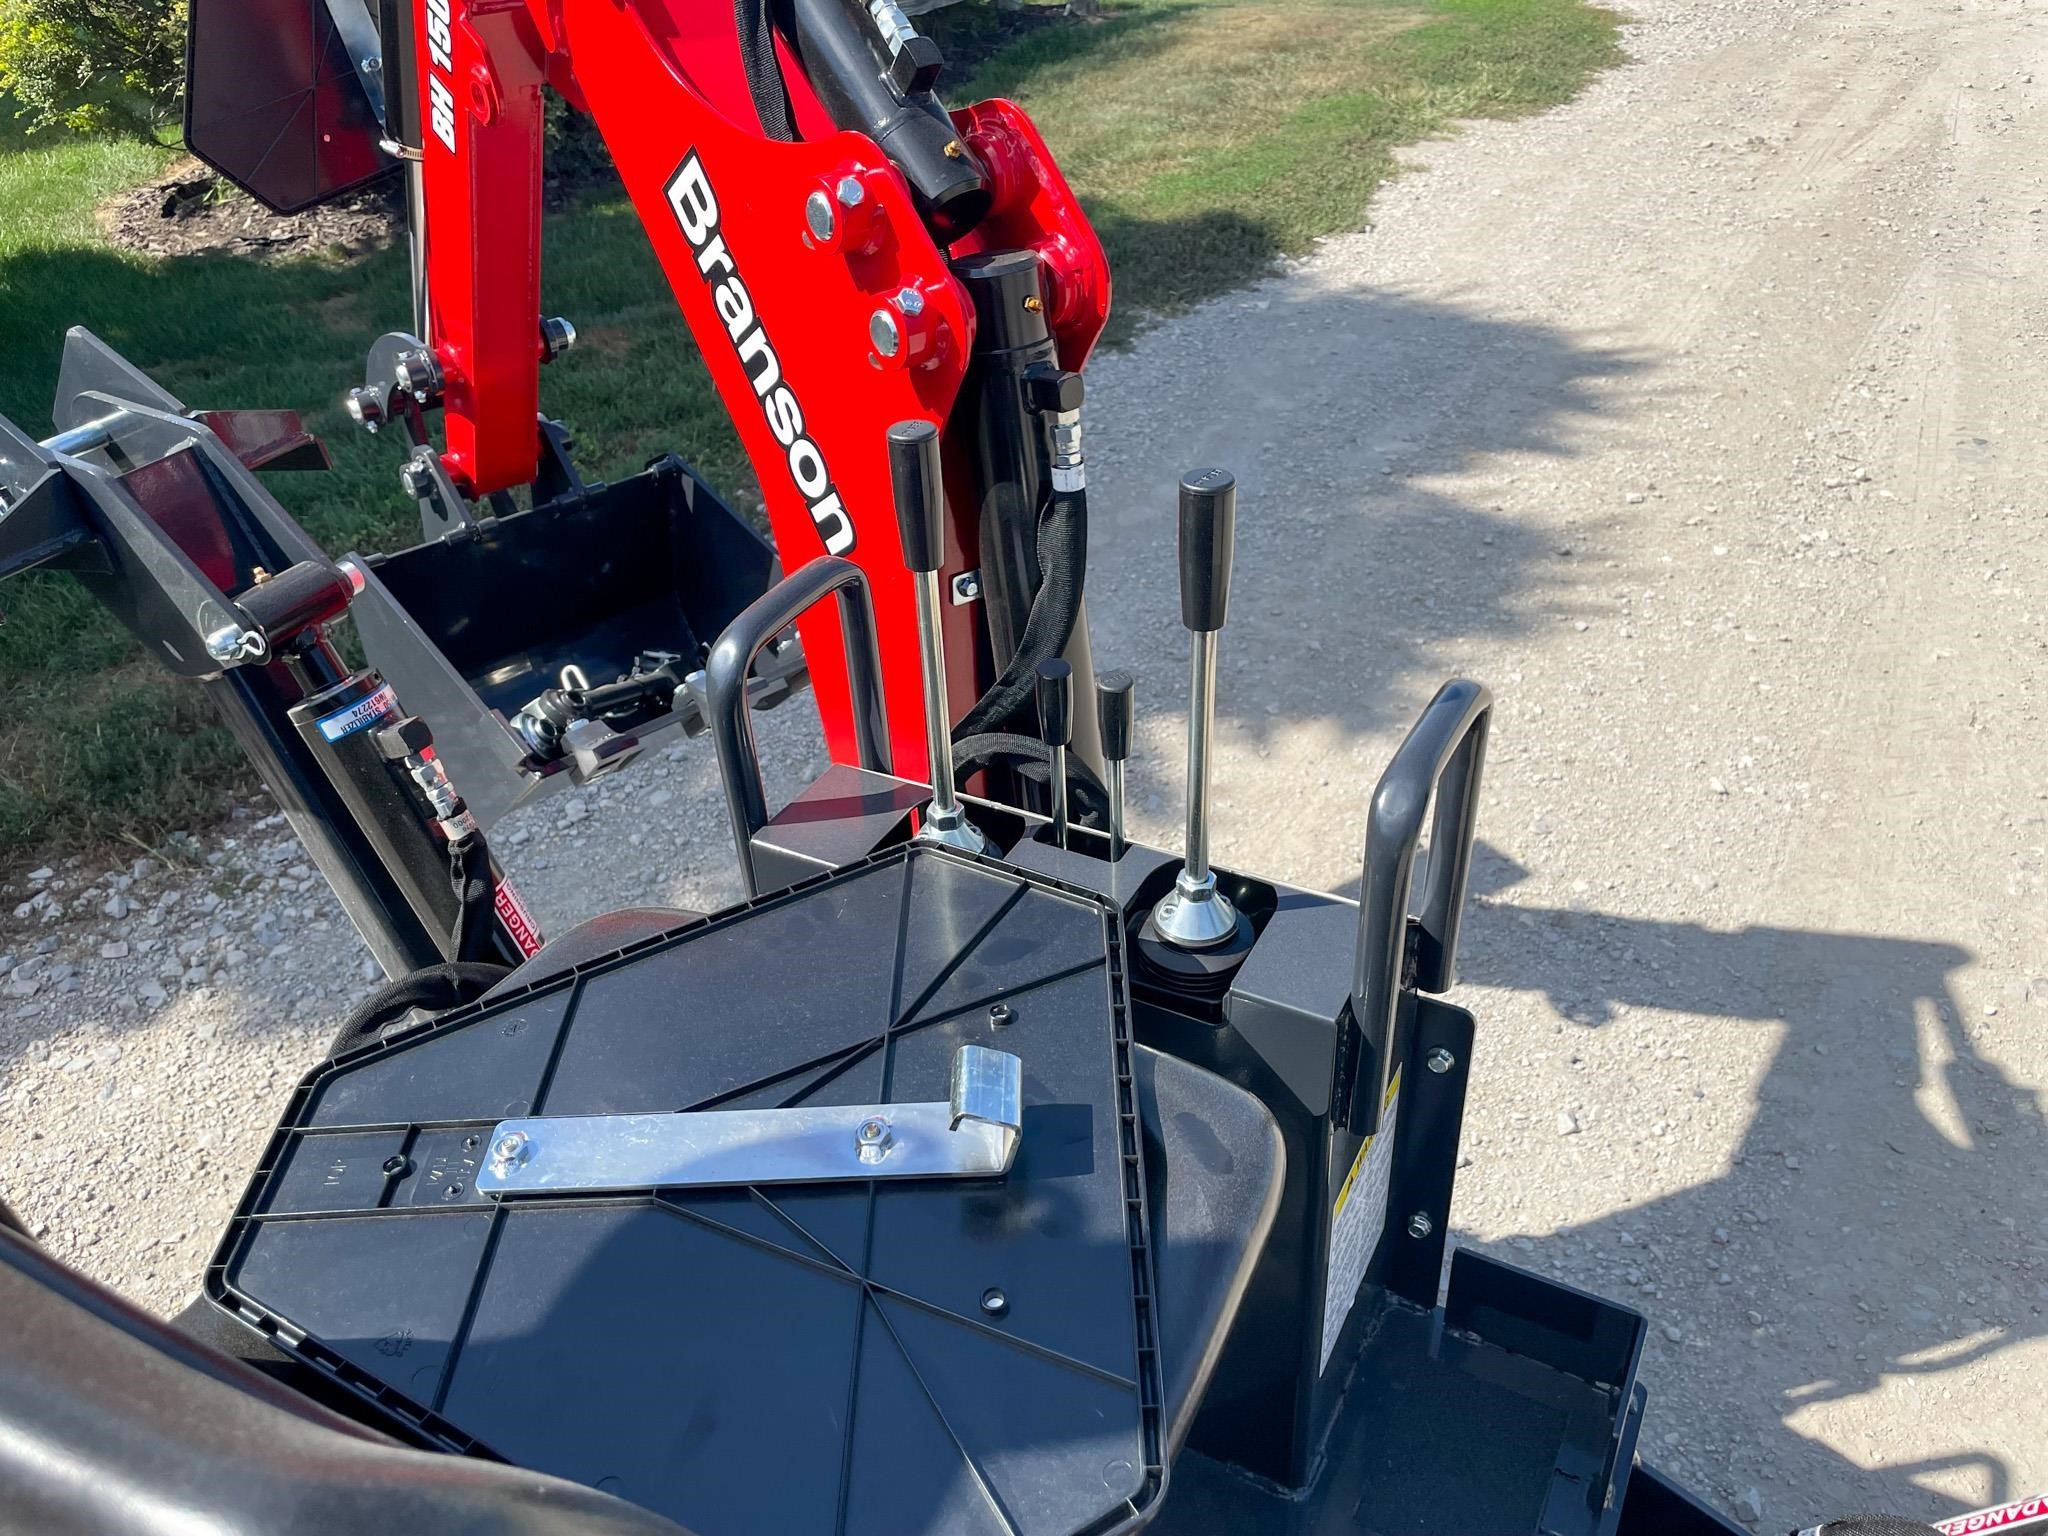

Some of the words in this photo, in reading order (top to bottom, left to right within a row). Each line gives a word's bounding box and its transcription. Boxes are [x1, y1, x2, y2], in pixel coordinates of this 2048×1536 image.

[429, 71, 456, 155] BH
[665, 154, 855, 556] Branson
[340, 705, 383, 734] STABILIZER
